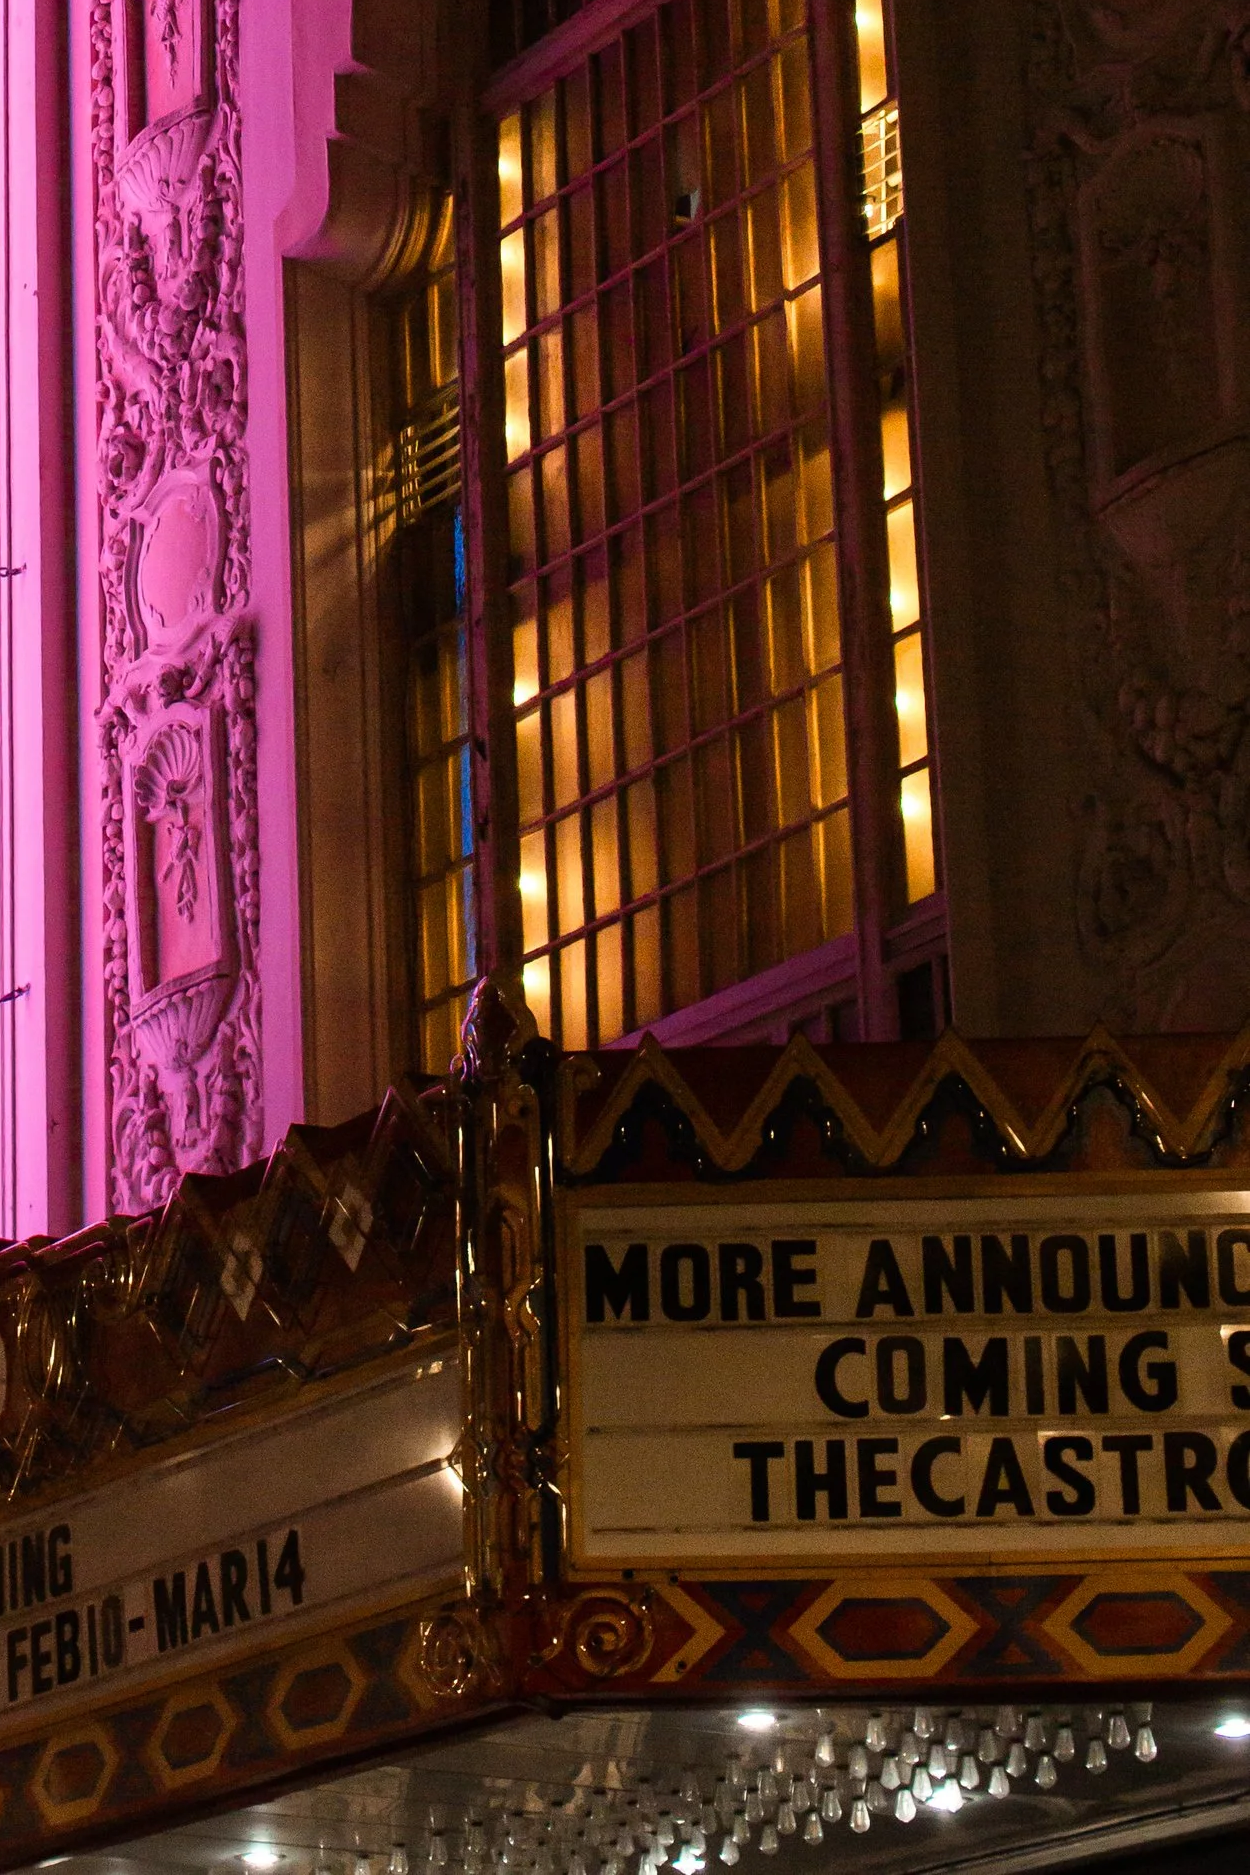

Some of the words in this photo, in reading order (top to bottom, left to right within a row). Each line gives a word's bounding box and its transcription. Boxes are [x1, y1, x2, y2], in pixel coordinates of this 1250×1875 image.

[584, 1239, 822, 1324] MORE
[855, 1229, 1250, 1319] ANNOUNC
[815, 1331, 1179, 1419] COMING
